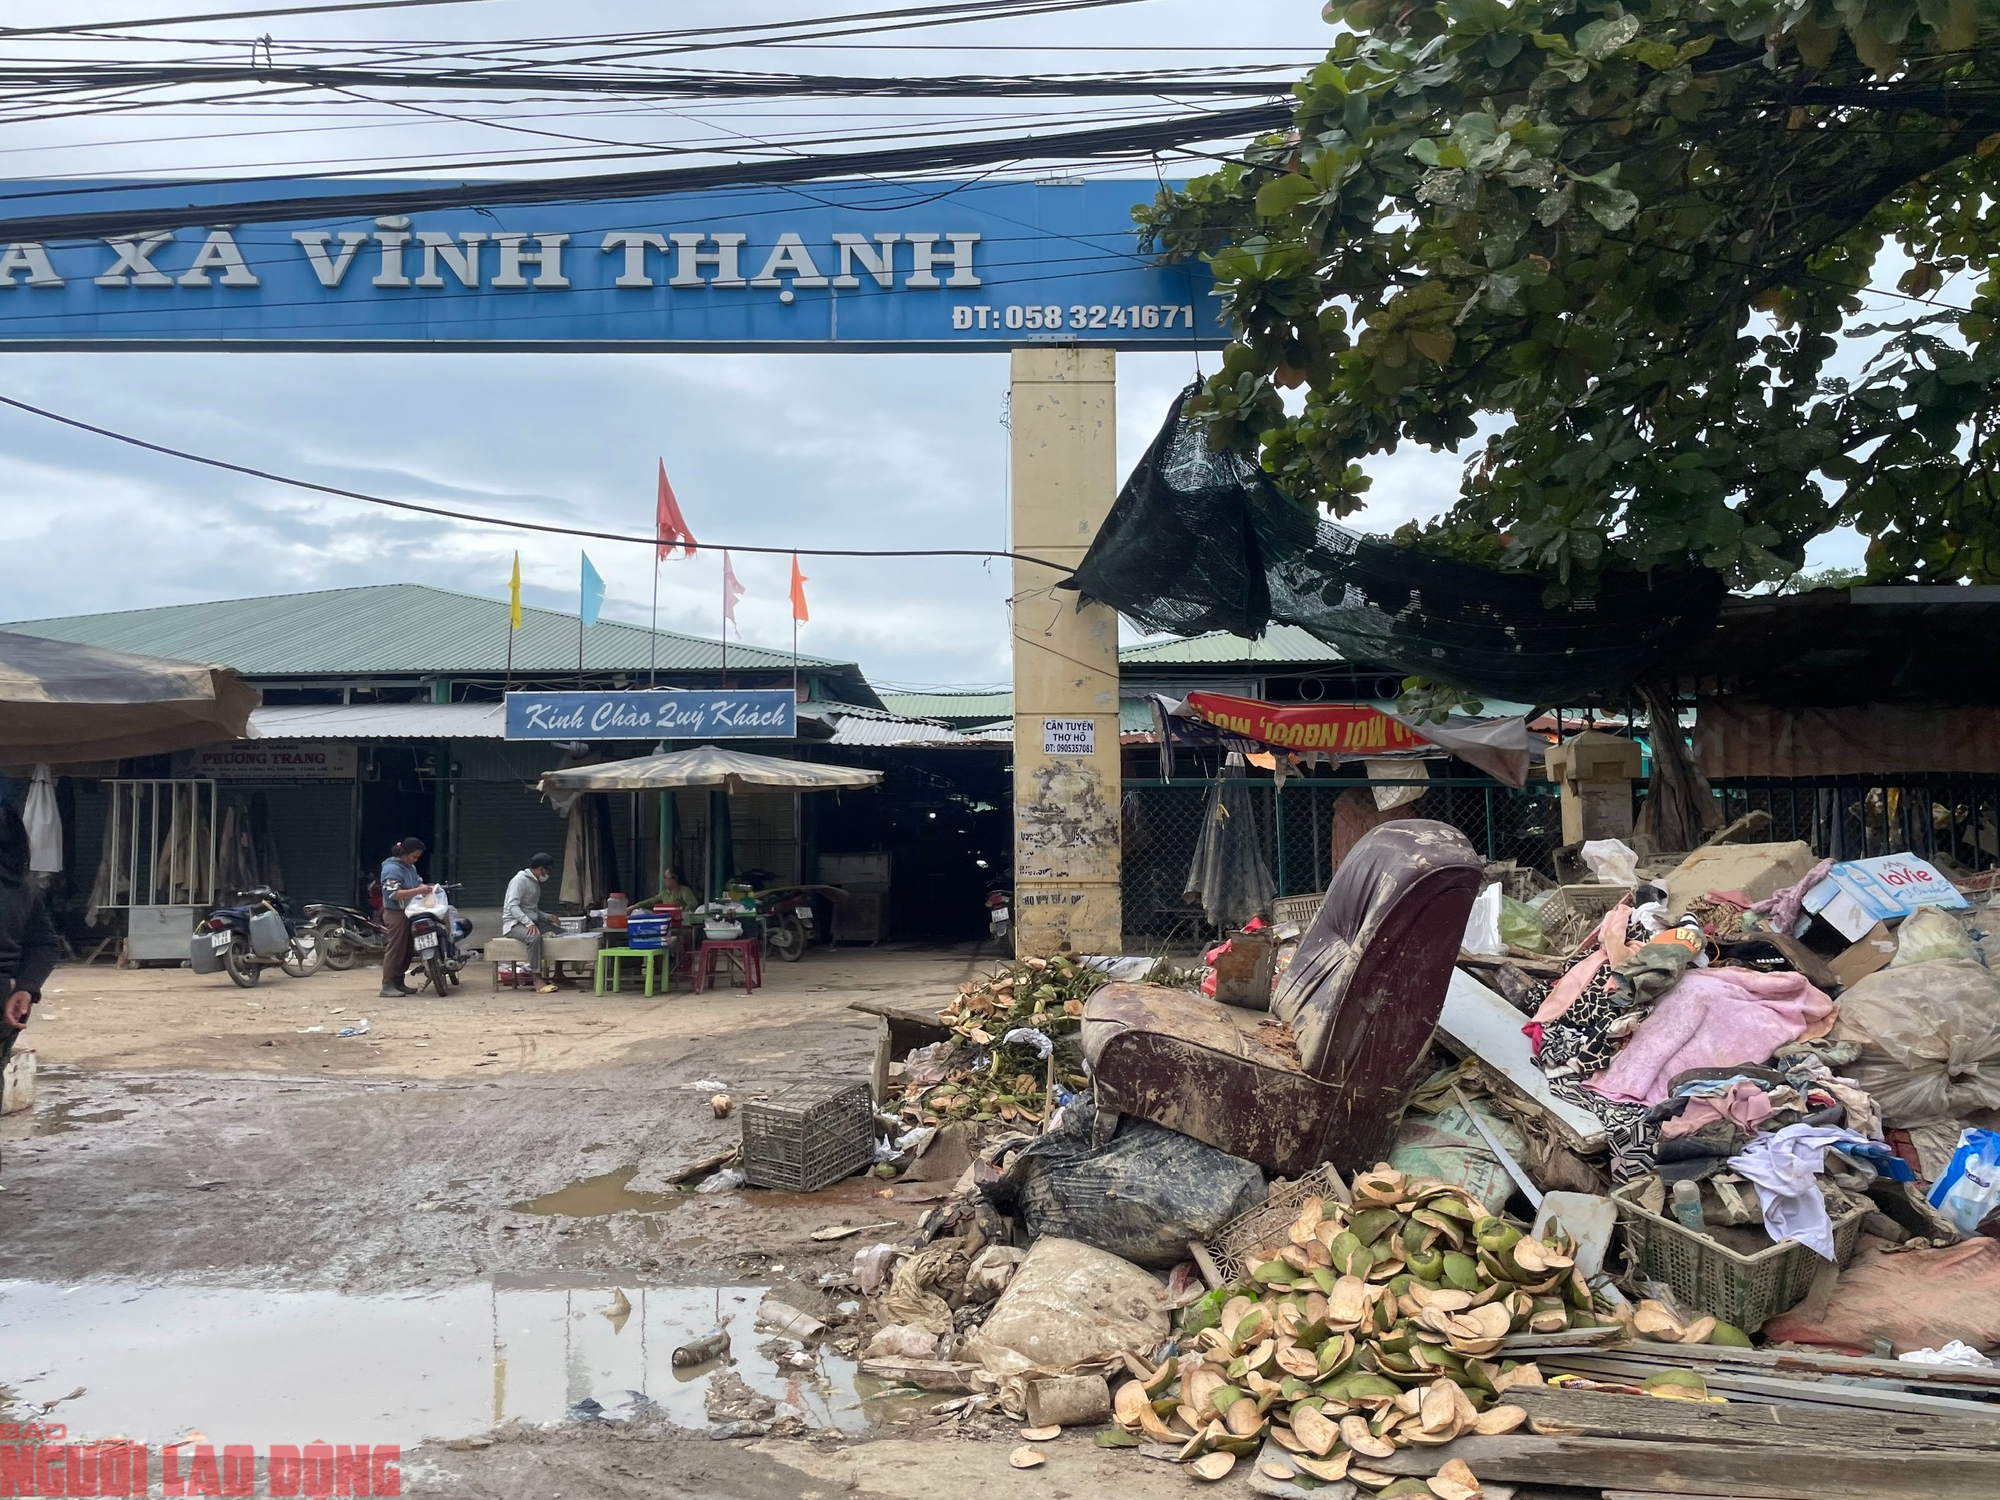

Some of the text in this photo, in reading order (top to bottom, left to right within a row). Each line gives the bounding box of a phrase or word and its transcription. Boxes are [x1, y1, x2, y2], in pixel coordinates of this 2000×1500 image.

[292, 214, 571, 288] VĨNH
[601, 233, 981, 304] THẠNH
[1069, 305, 1193, 329] 3241671
[525, 700, 787, 732] Kính Chào Quý Khách
[1045, 719, 1064, 731] CẦN
[1053, 733, 1071, 743] THỢ
[271, 752, 326, 765] TRANG
